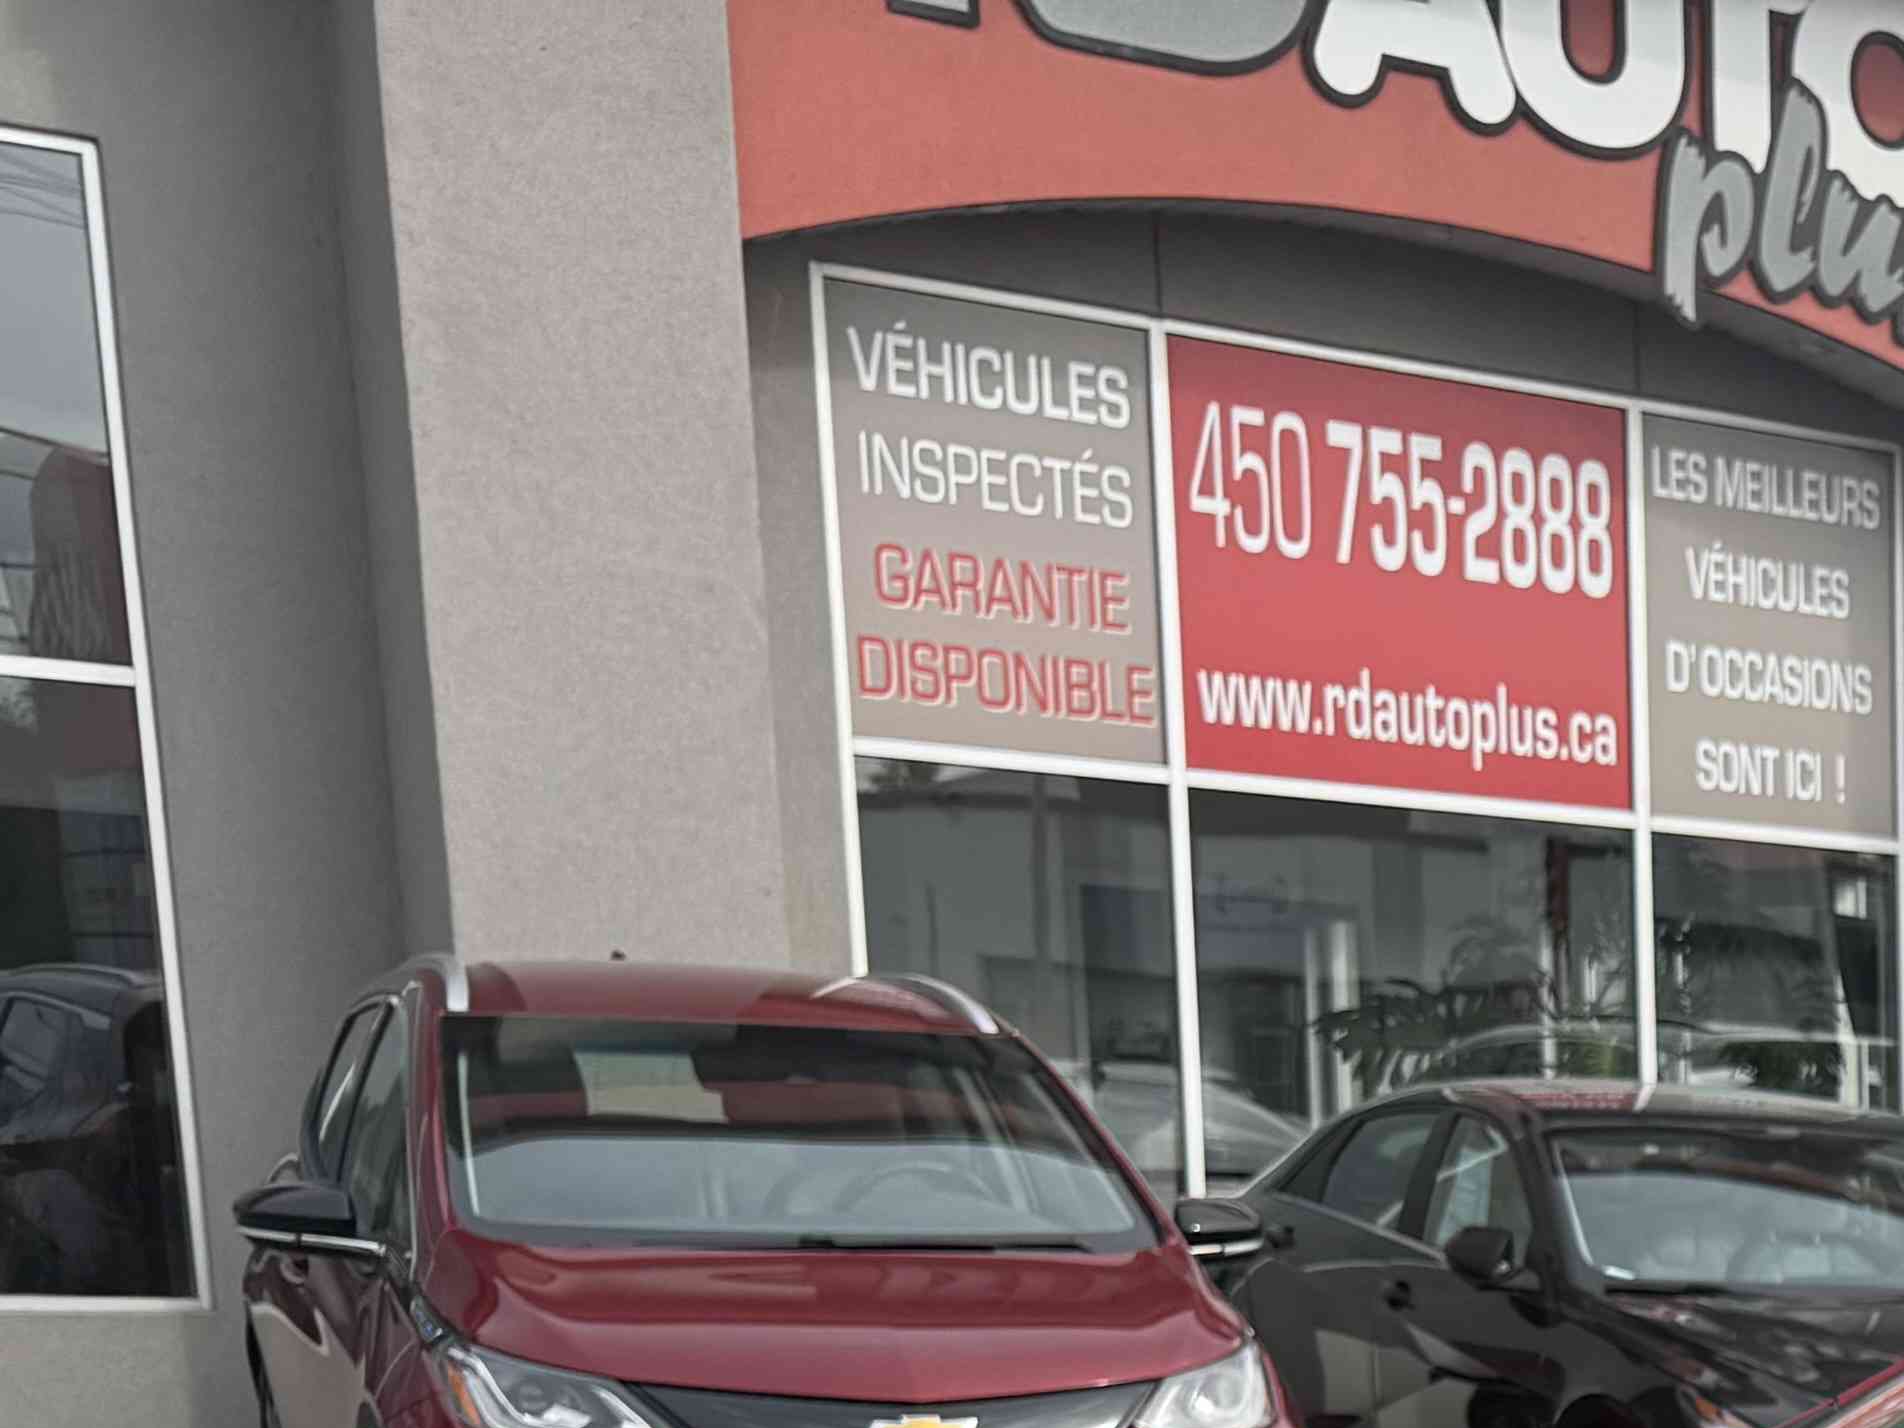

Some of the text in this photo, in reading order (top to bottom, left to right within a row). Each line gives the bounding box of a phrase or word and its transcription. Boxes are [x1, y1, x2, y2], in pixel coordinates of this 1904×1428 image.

[847, 322, 1131, 428] VÉHICULES
[858, 430, 1133, 528] INSPECTÉS
[1190, 400, 1614, 599] 450 755-2888
[1651, 445, 1881, 529] LES MEILLEURS
[873, 543, 1132, 635] GARANTIE
[1685, 541, 1850, 619] VÉHICULES
[856, 634, 1158, 728] DISPONIBLE
[1197, 667, 1618, 772] www.rdautoplus.ca
[1695, 737, 1779, 797] SONT
[1785, 750, 1822, 802] ICI
